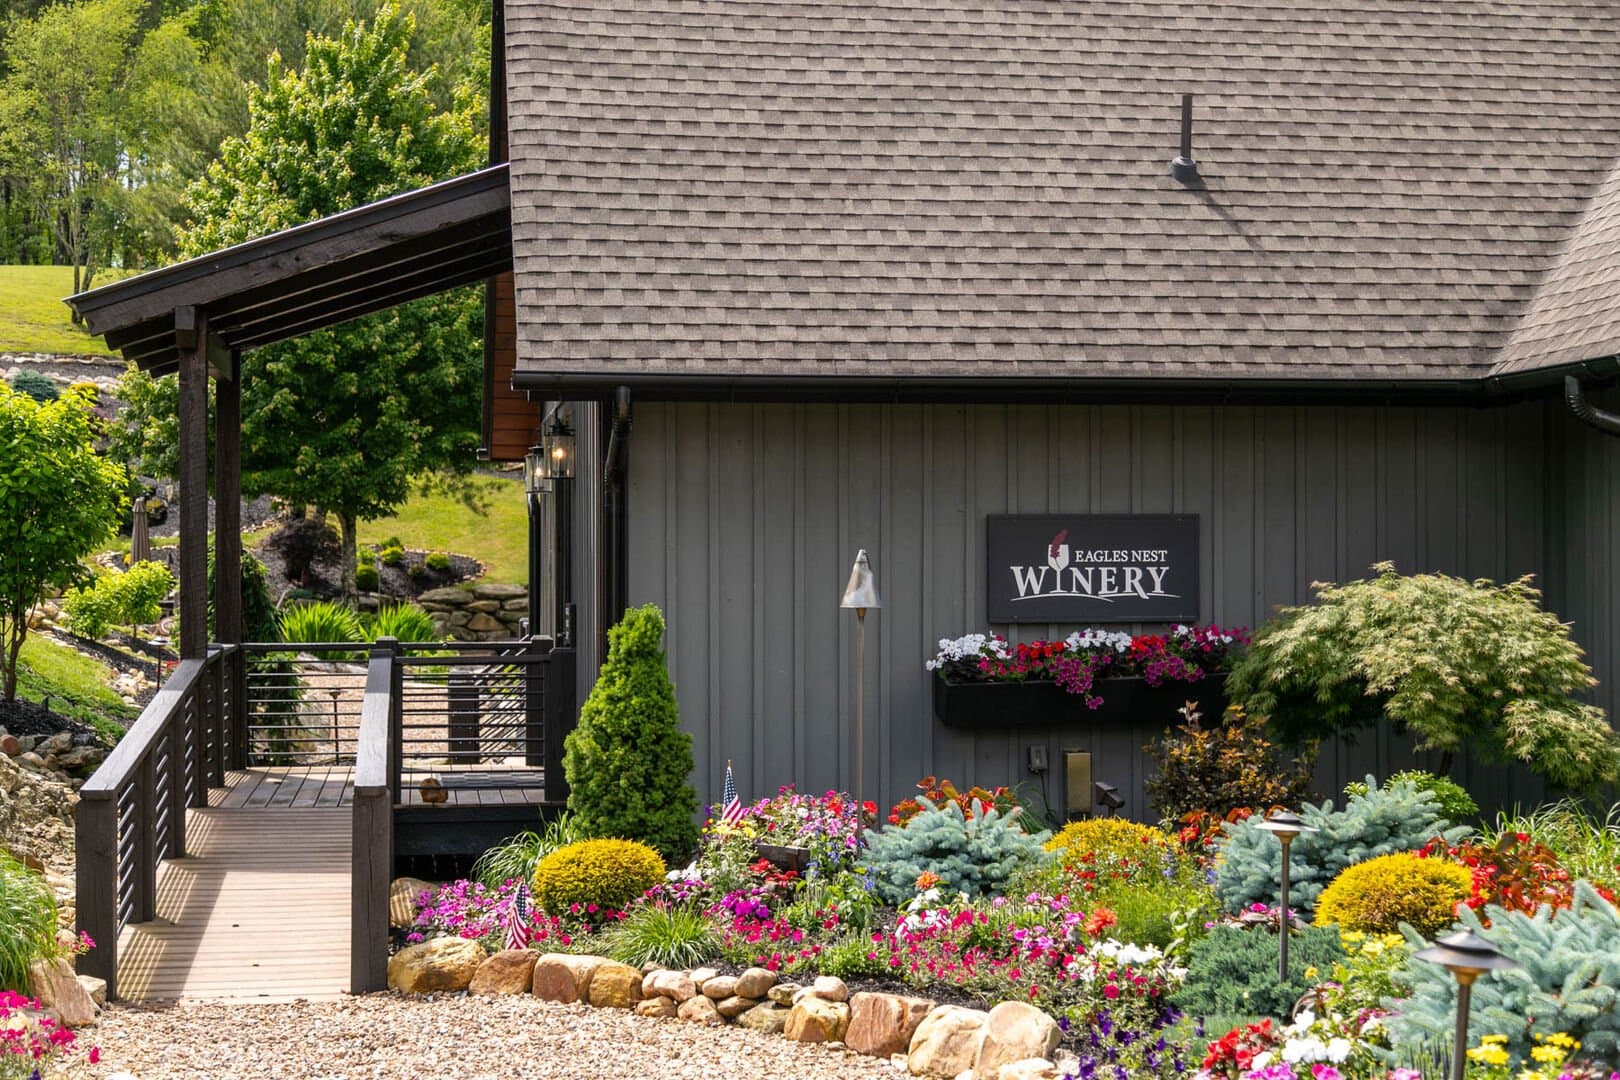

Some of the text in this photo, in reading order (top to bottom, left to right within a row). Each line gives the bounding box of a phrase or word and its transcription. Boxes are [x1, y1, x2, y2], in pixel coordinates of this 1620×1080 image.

[1075, 550, 1168, 563] EAGLES NEST
[1010, 563, 1170, 600] WINERY
